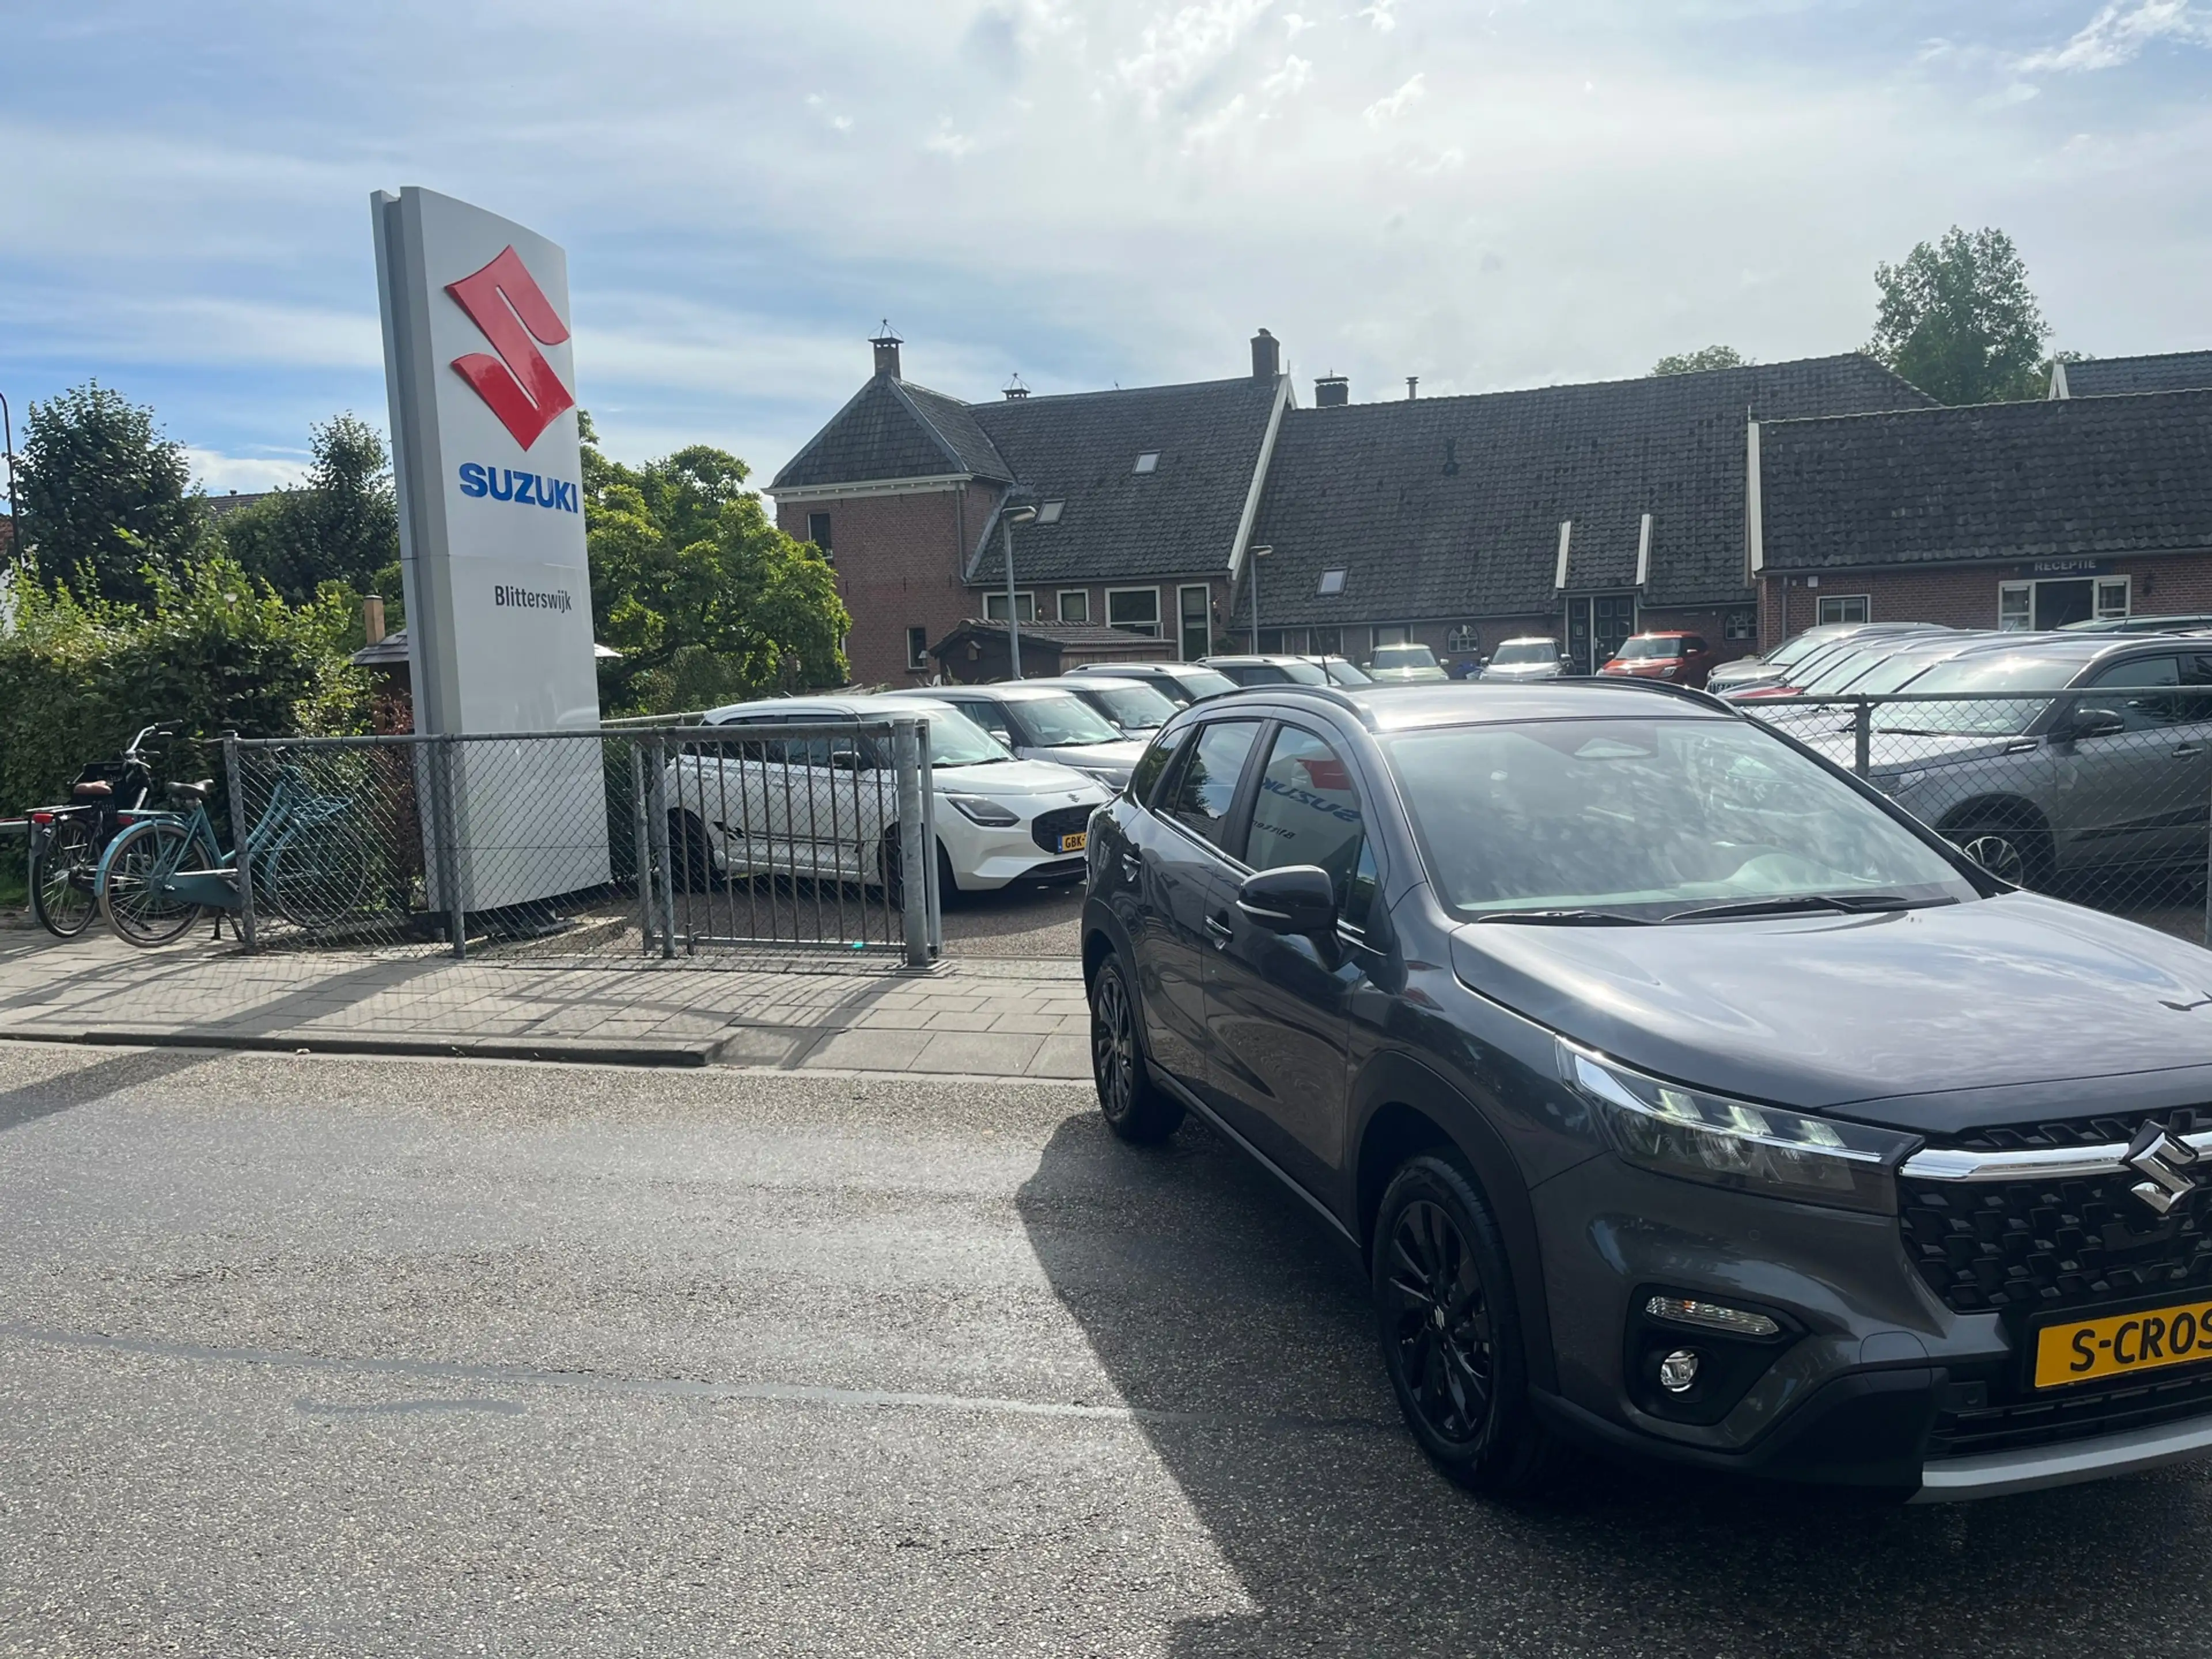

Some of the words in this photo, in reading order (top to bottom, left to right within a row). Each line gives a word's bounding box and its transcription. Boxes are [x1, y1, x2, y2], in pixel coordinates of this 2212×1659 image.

[459, 463, 578, 513] SUZUKI
[2035, 559, 2097, 571] RECEPTIE
[495, 585, 571, 613] Blitterswijk
[1066, 834, 1086, 849] GBK-
